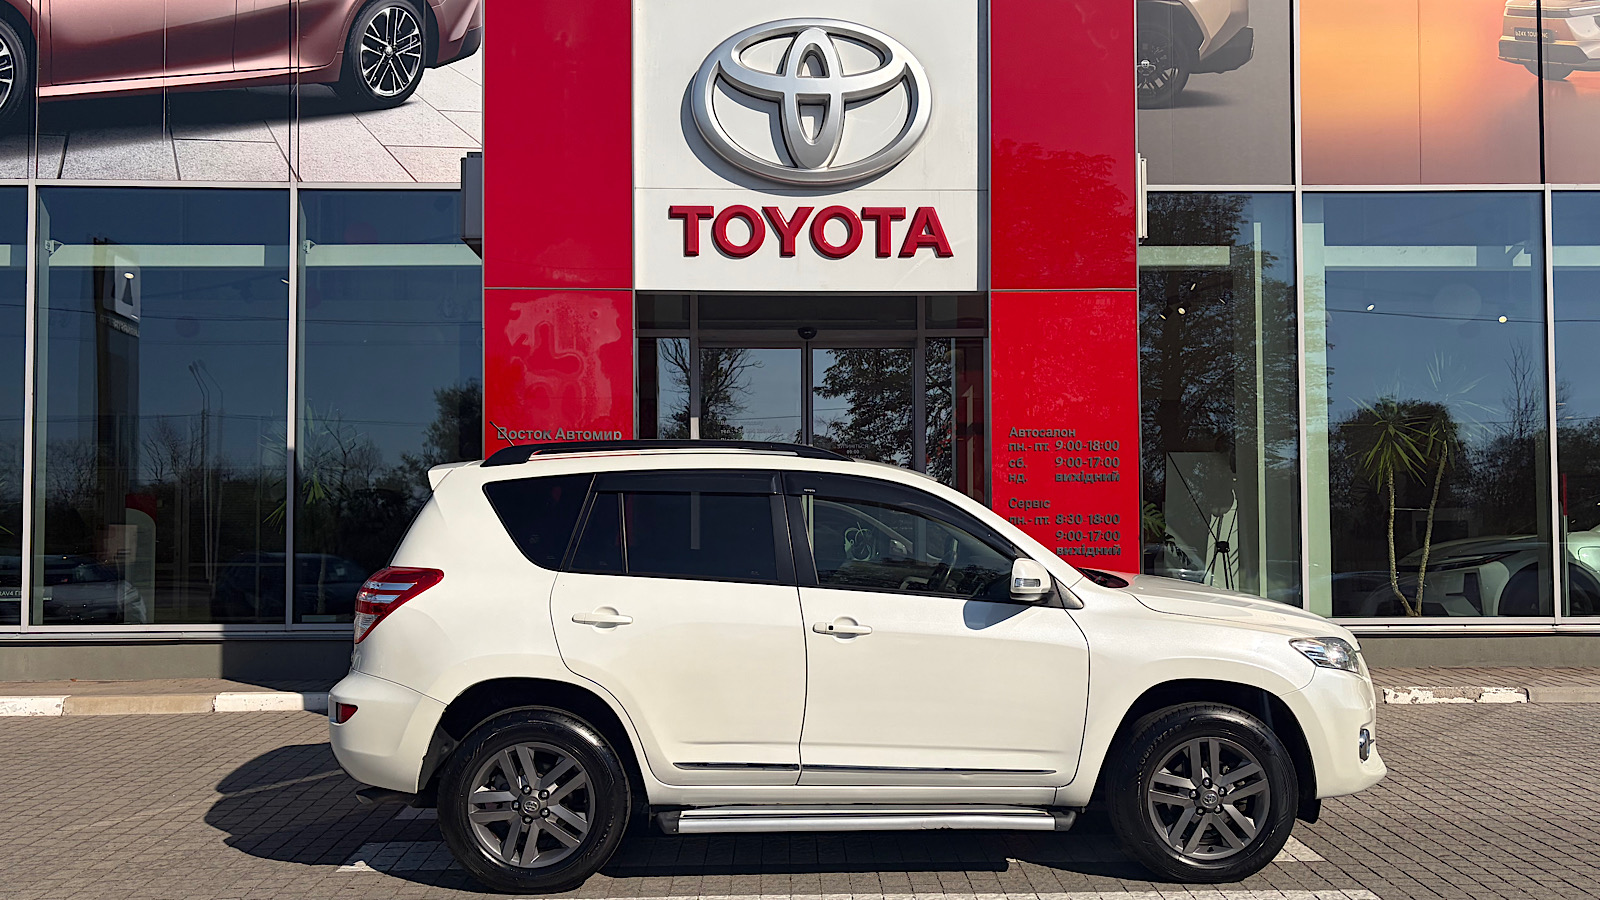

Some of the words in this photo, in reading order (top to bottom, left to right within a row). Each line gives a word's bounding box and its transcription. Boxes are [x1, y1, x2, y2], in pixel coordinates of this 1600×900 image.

[668, 204, 954, 260] TOYOTA
[497, 426, 552, 441] Восток
[555, 427, 623, 441] Автомир
[1009, 427, 1076, 438] Автосалон
[1055, 440, 1120, 452] 9:00-18:00
[1008, 457, 1027, 468] сб.
[1055, 456, 1120, 468] 9:00-17:00
[1008, 473, 1027, 483] нд.
[1055, 471, 1120, 483] вихідний
[1008, 497, 1051, 510] Сервіс
[1055, 530, 1121, 542] 9:00-17:00
[1056, 544, 1121, 557] вихідний
